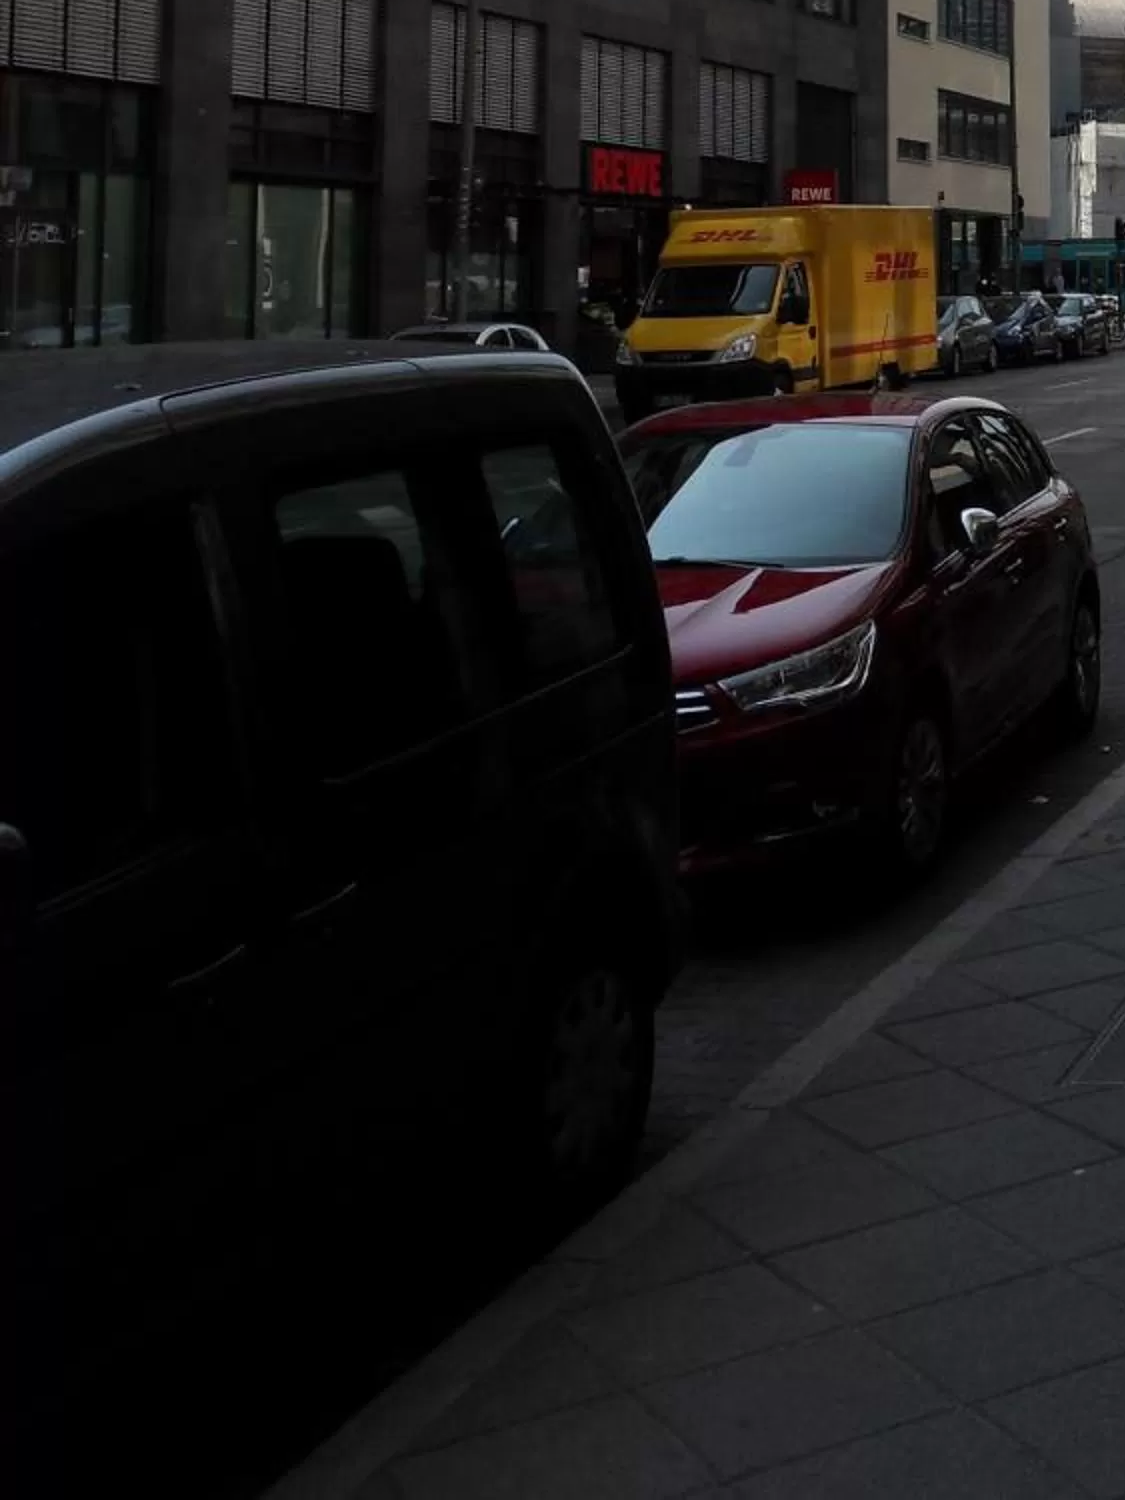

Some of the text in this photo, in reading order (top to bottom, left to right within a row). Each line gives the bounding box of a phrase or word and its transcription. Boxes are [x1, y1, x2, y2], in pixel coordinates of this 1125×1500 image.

[590, 146, 664, 198] REWE
[791, 186, 833, 202] REWE
[690, 229, 759, 243] DHL
[874, 251, 923, 281] DHL
